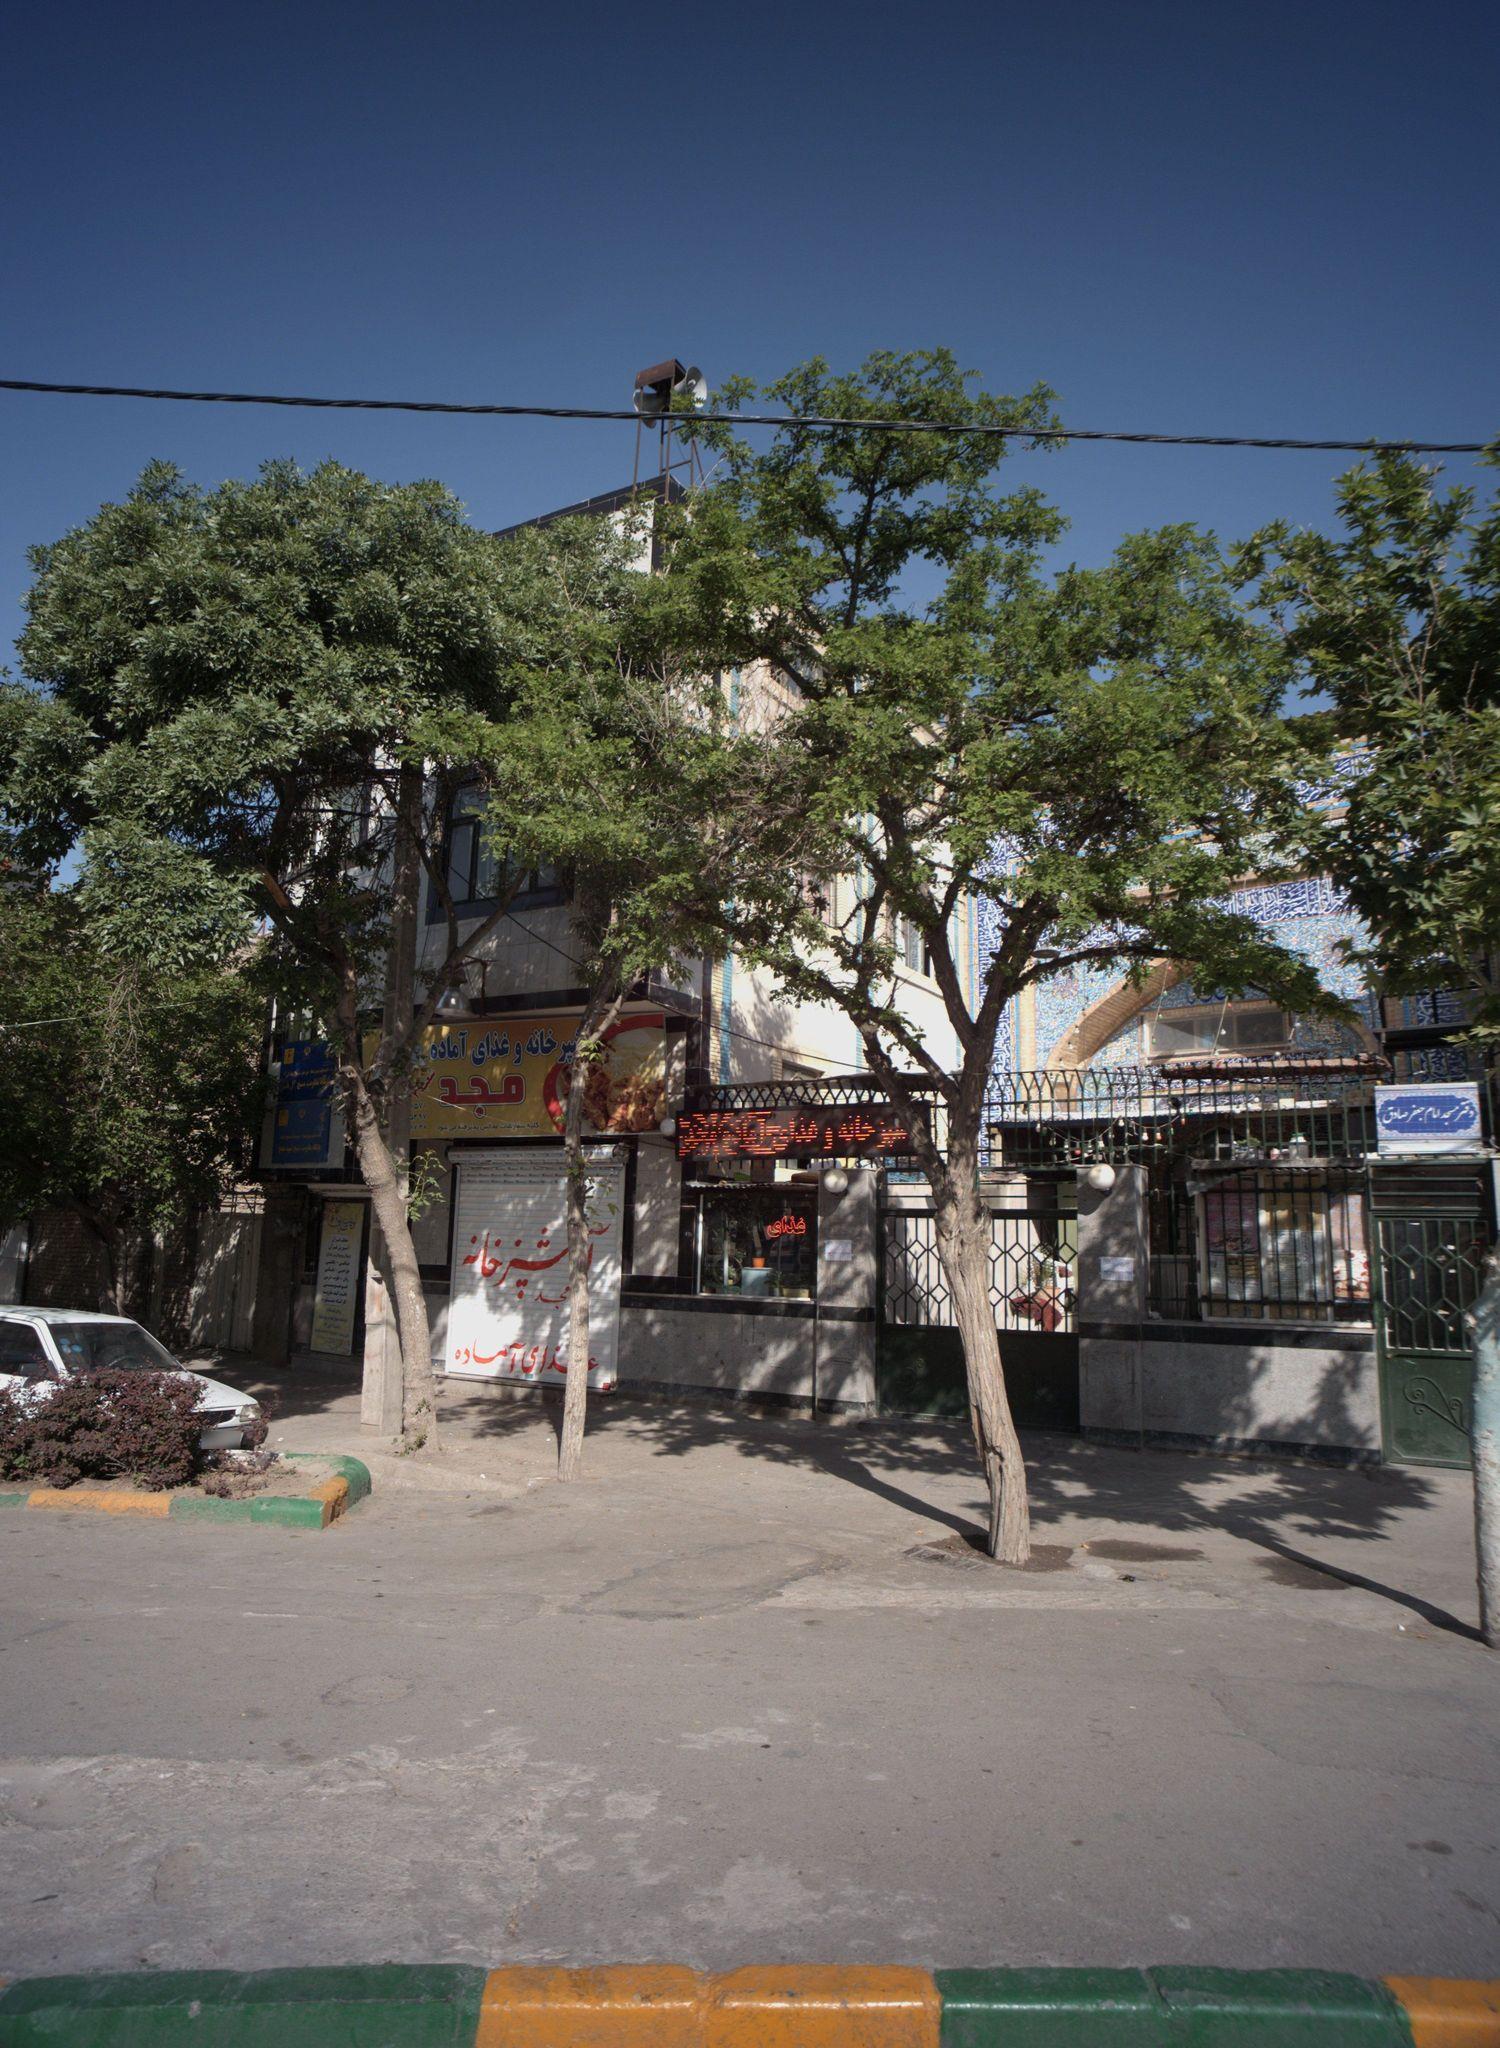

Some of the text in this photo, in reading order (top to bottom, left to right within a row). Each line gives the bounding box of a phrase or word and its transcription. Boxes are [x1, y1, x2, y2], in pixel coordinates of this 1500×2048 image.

[429, 1030, 468, 1061] آماده
[471, 1030, 510, 1066] غذای
[512, 1039, 522, 1066] و
[439, 1074, 526, 1118] مجد
[1382, 1100, 1475, 1126] دفتر مسجد امام جعفر صادق
[767, 1215, 807, 1238] غذای
[455, 1339, 526, 1374] آماده
